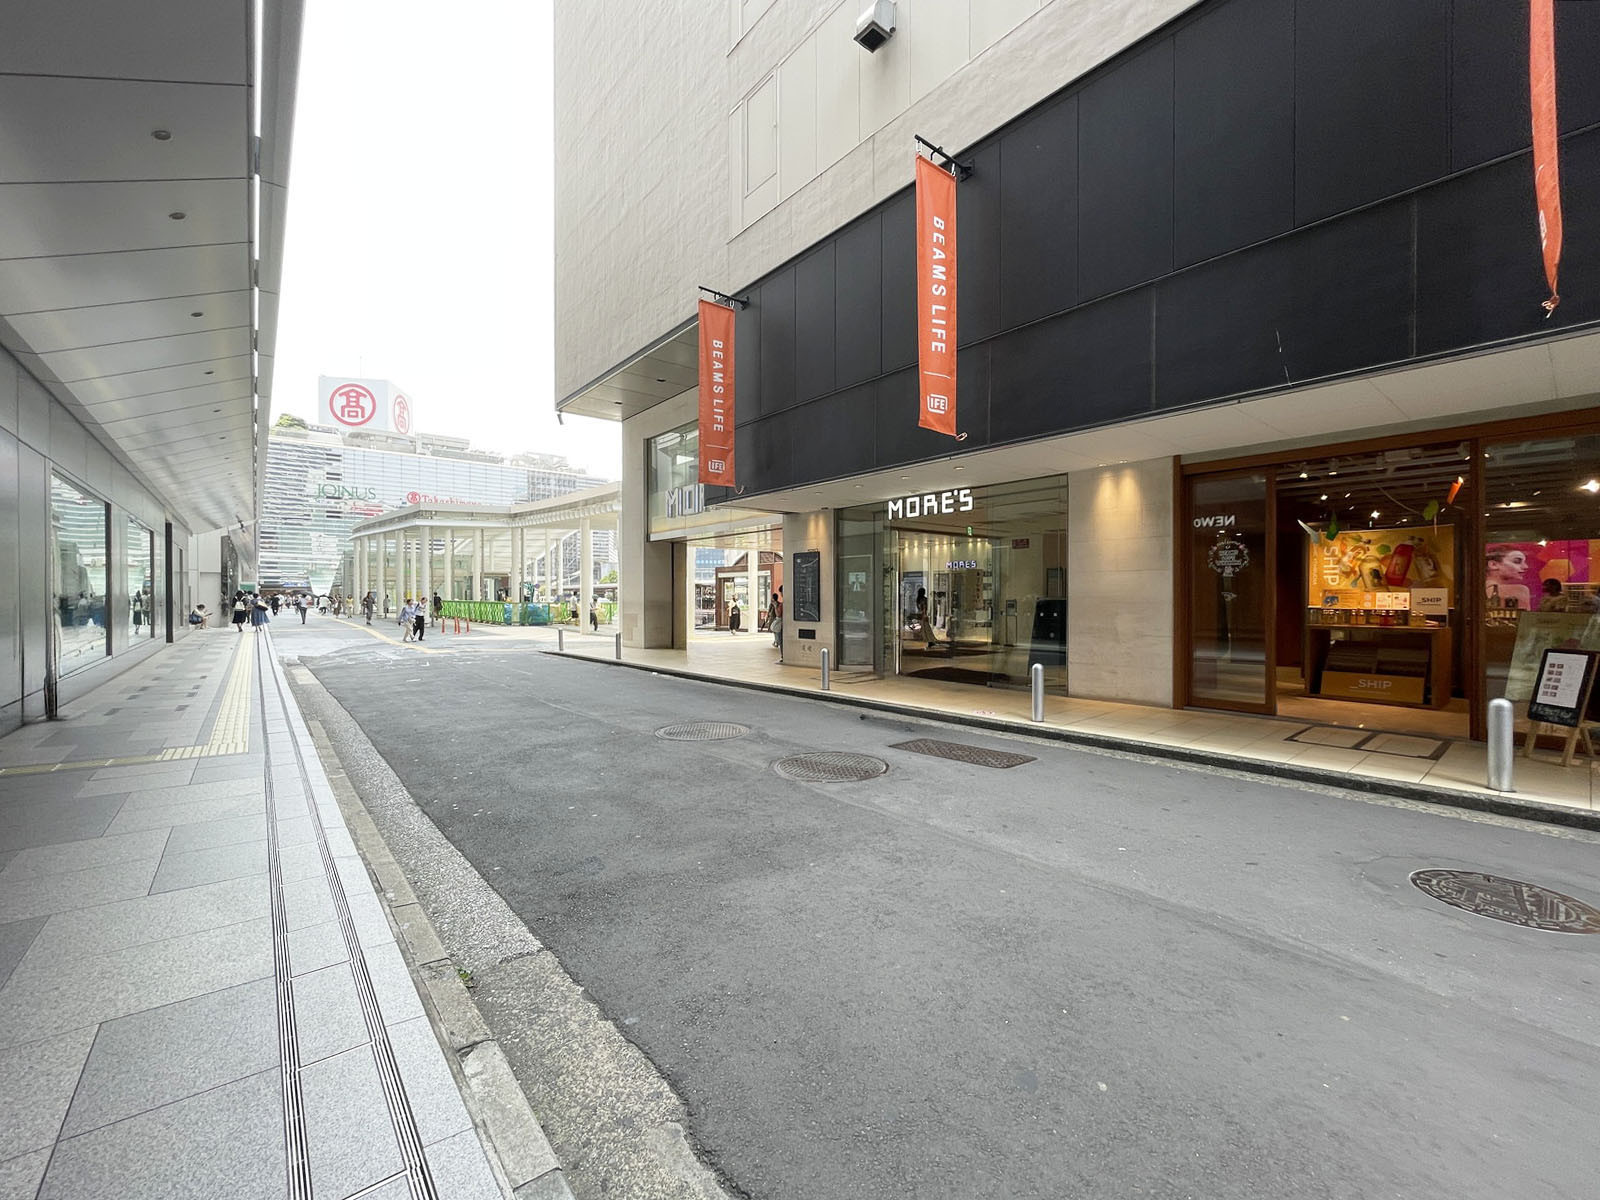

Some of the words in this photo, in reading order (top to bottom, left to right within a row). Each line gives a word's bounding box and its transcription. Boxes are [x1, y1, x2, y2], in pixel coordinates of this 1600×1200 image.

[931, 215, 946, 297] BEAMS
[931, 304, 946, 353] LIFE
[712, 339, 724, 394] BEAMS
[713, 399, 724, 433] LIFE
[314, 483, 377, 500] JOINUS
[888, 488, 974, 521] MORE'S
